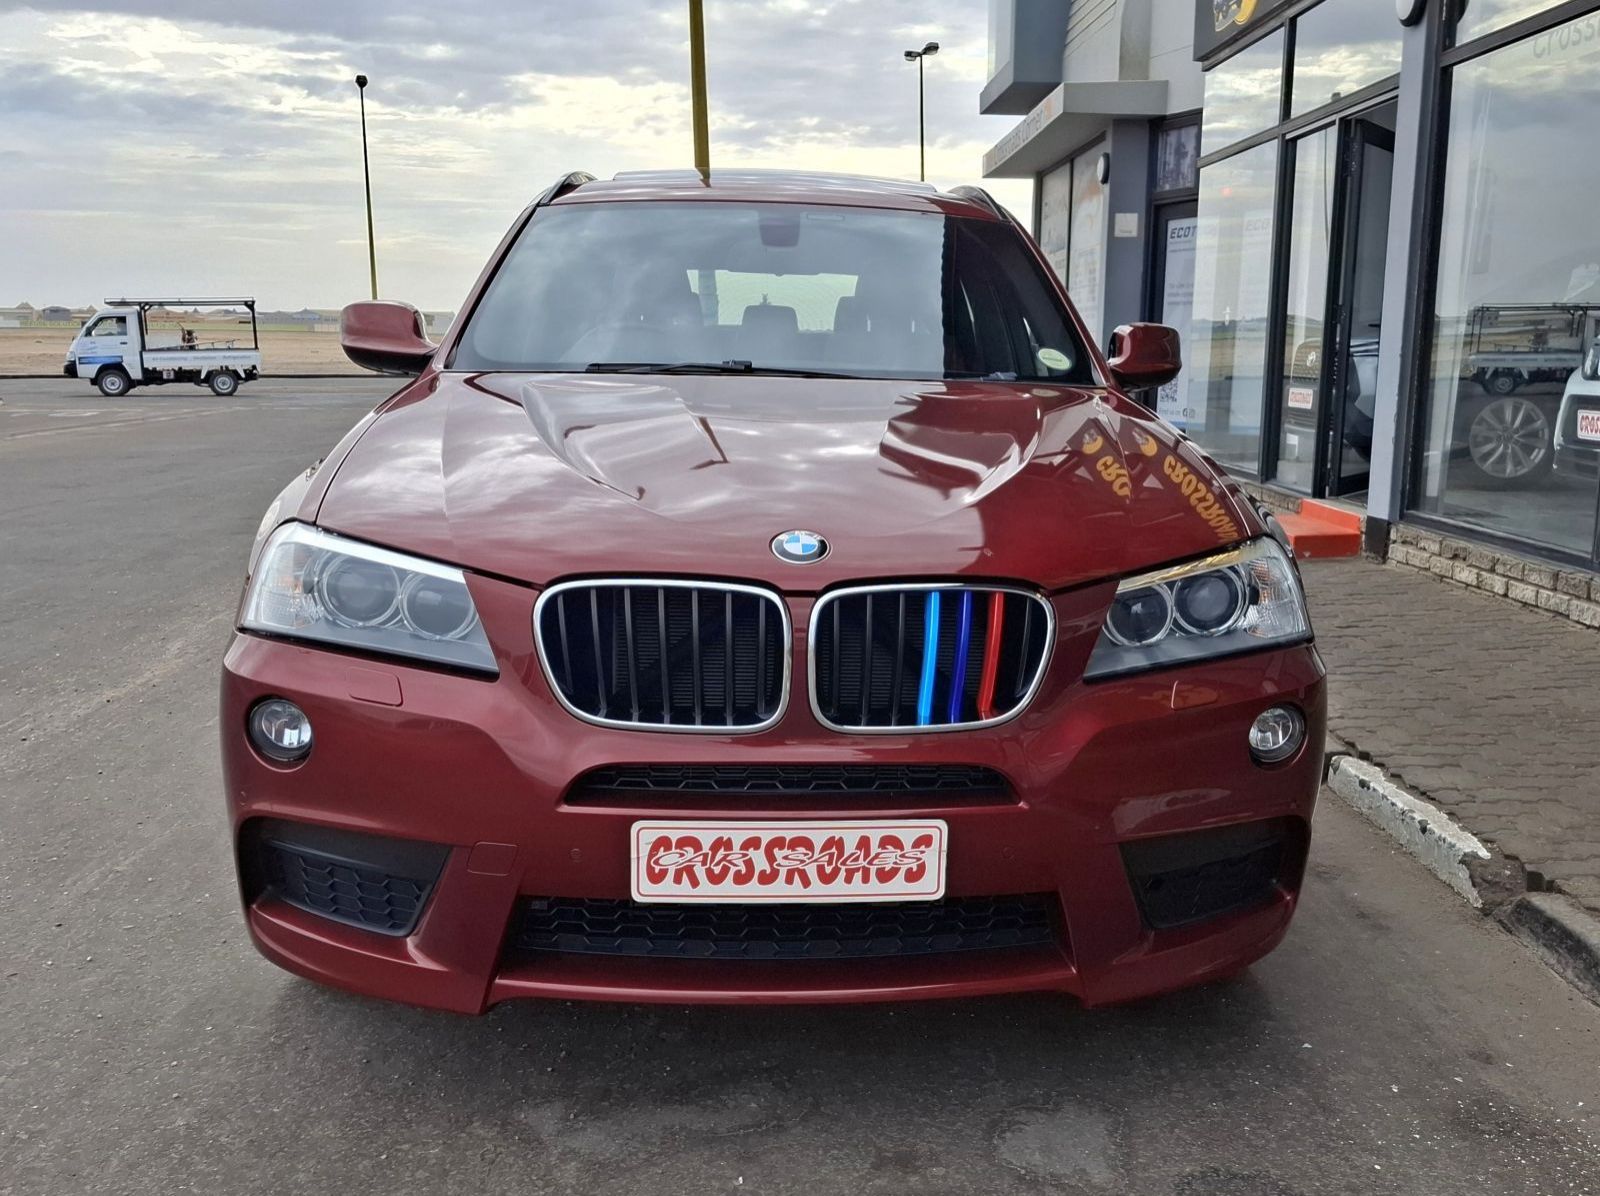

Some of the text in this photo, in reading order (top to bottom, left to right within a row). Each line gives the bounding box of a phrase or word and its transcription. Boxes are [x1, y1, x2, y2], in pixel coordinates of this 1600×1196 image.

[645, 834, 934, 889] CROSSROADS
[651, 848, 926, 868] CAR SALES
